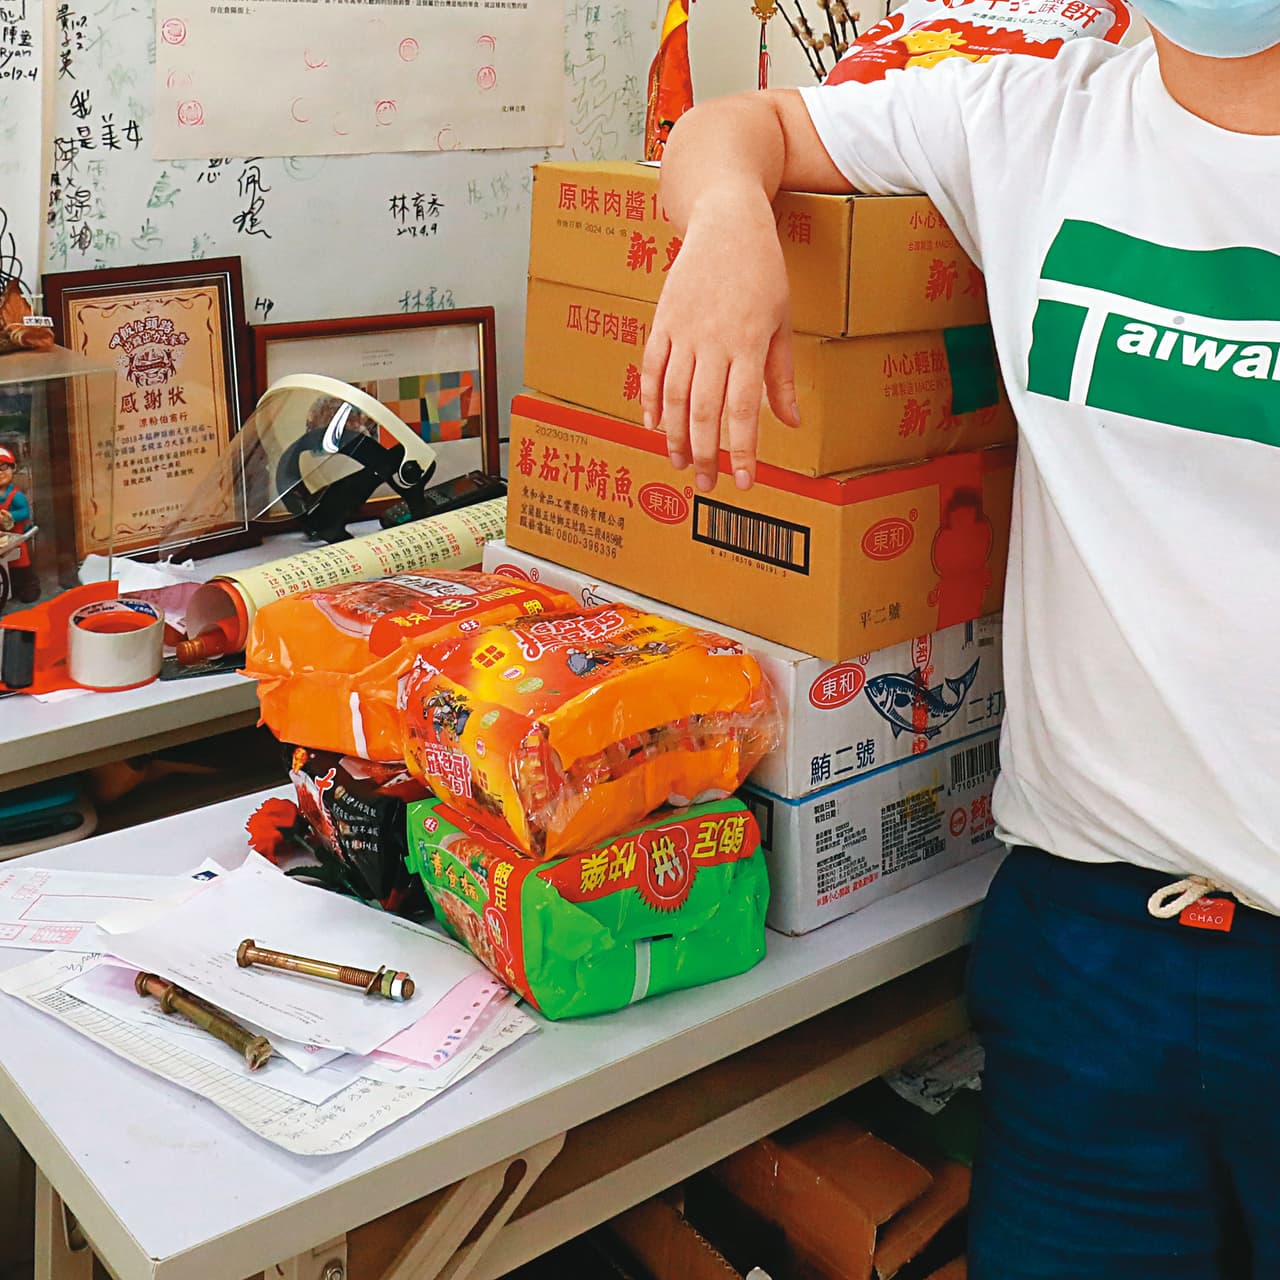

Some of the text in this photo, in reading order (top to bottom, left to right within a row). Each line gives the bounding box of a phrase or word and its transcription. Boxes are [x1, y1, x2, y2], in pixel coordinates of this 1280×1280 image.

[0, 47, 32, 68] Ryan
[558, 182, 670, 222] 原味肉醬1
[566, 303, 652, 347] 瓜仔肉醬1
[120, 386, 188, 414] 感謝狀
[515, 438, 635, 509] 蕃茄汁鯖魚
[648, 493, 680, 518] 東和
[872, 524, 906, 554] 東和
[821, 669, 856, 701] 東和
[809, 737, 876, 786] 鮪二號
